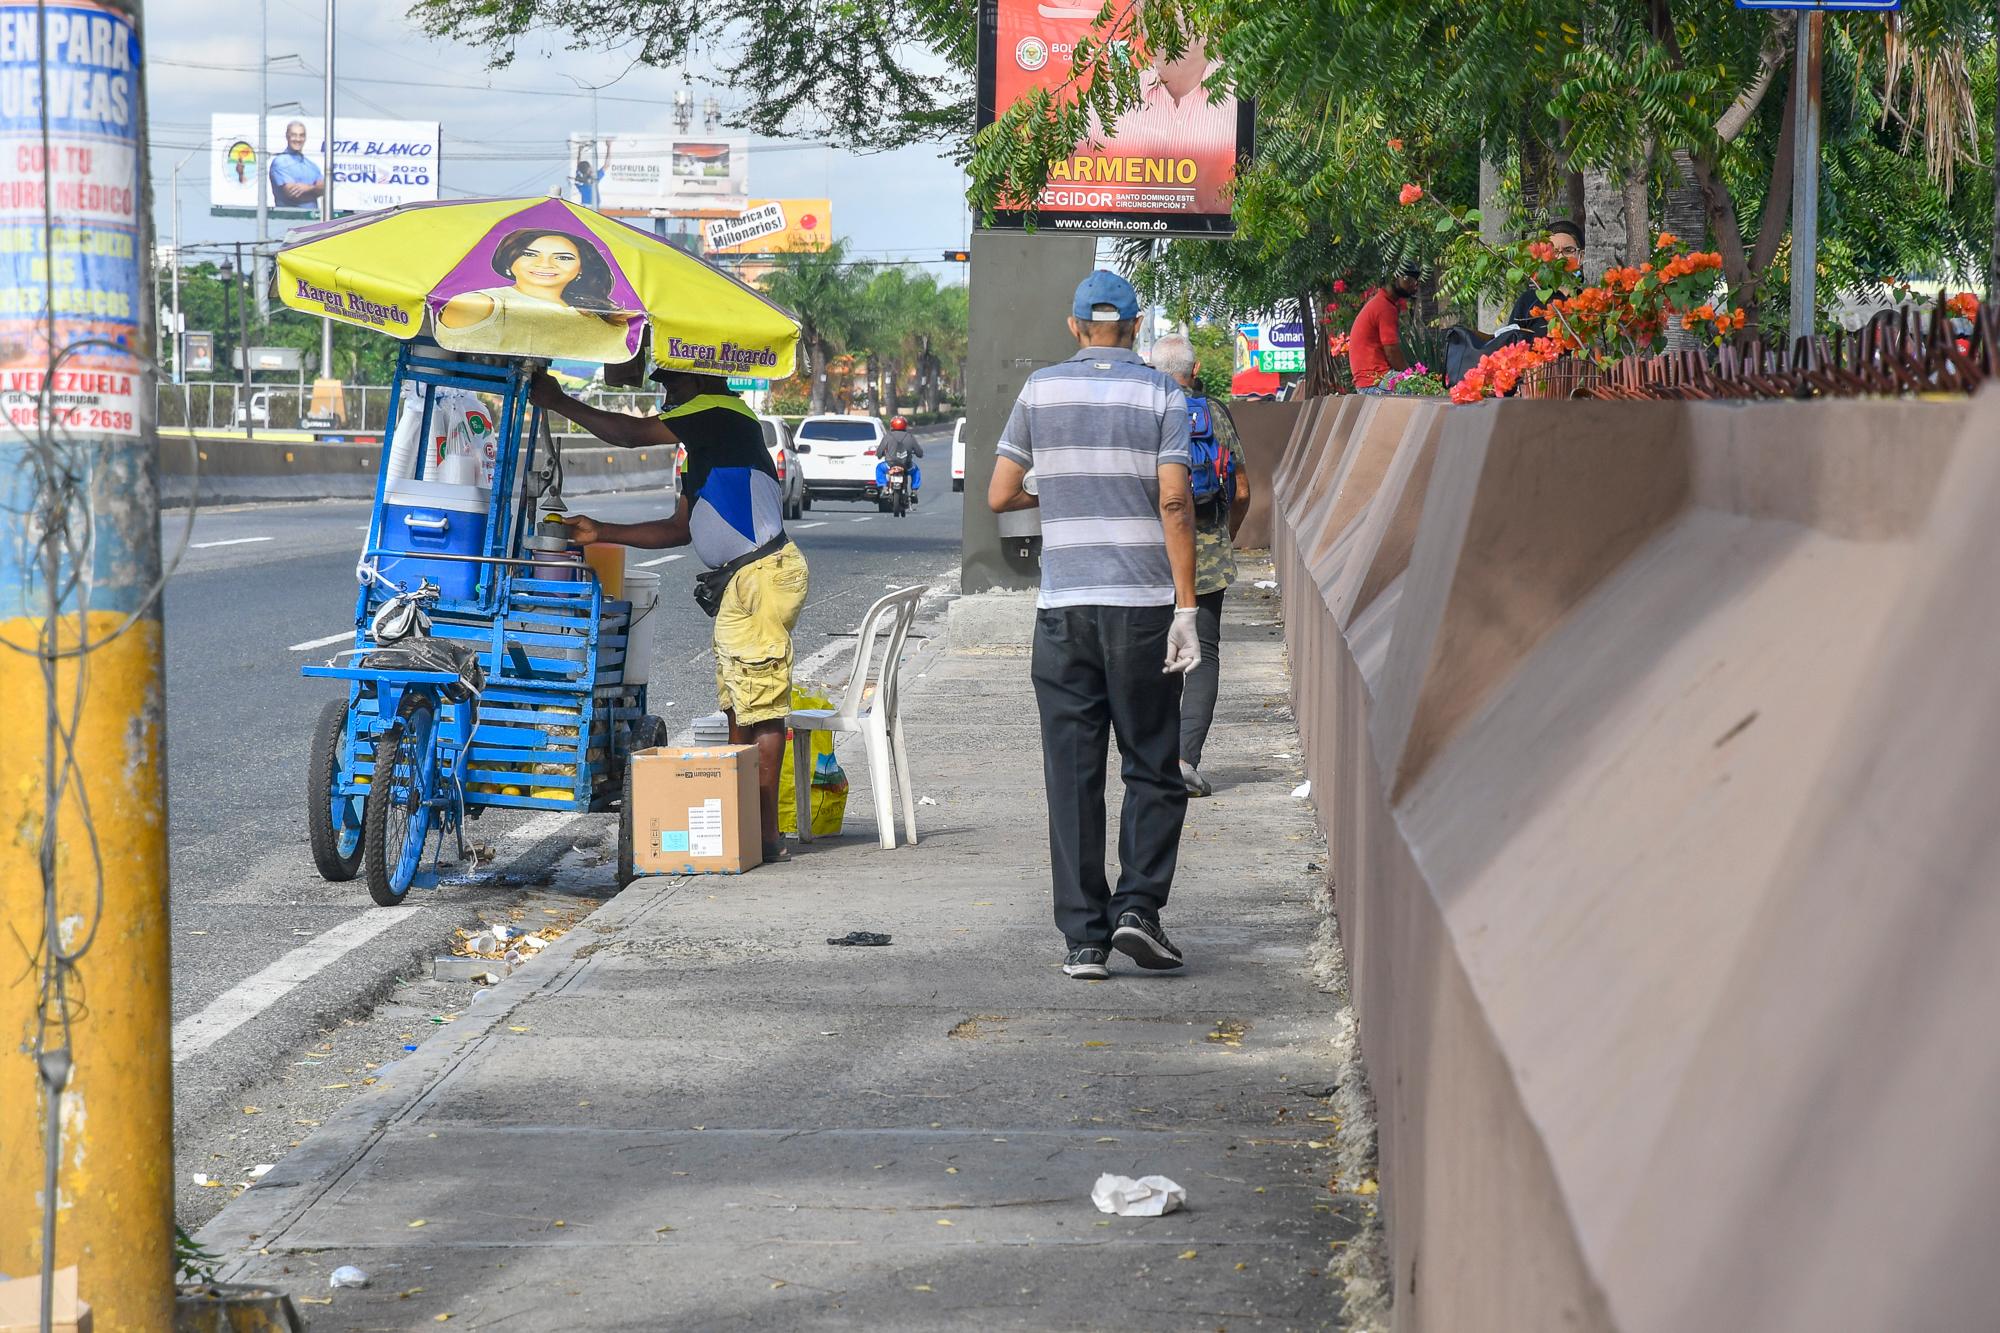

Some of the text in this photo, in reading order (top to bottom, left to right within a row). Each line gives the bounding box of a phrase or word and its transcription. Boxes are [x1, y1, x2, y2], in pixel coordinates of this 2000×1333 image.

[47, 13, 130, 72] PARA
[48, 69, 128, 125] VEAS
[321, 141, 432, 156] OTA BLANCO
[17, 144, 93, 175] CON TU
[392, 165, 427, 173] 2020
[1048, 156, 1197, 184] ARMENIO
[333, 172, 430, 185] GONZALO
[373, 195, 394, 204] VOTA
[1116, 200, 1180, 209] CIRCUNSCRIPCIÓN
[1141, 194, 1175, 202] DOMINGO
[764, 206, 778, 217] de
[1055, 218, 1168, 230] www.colorin.com.do
[713, 217, 782, 247] Millonarios!
[296, 277, 410, 326] Karen Ricardo
[668, 337, 777, 367] Karen Ricardo
